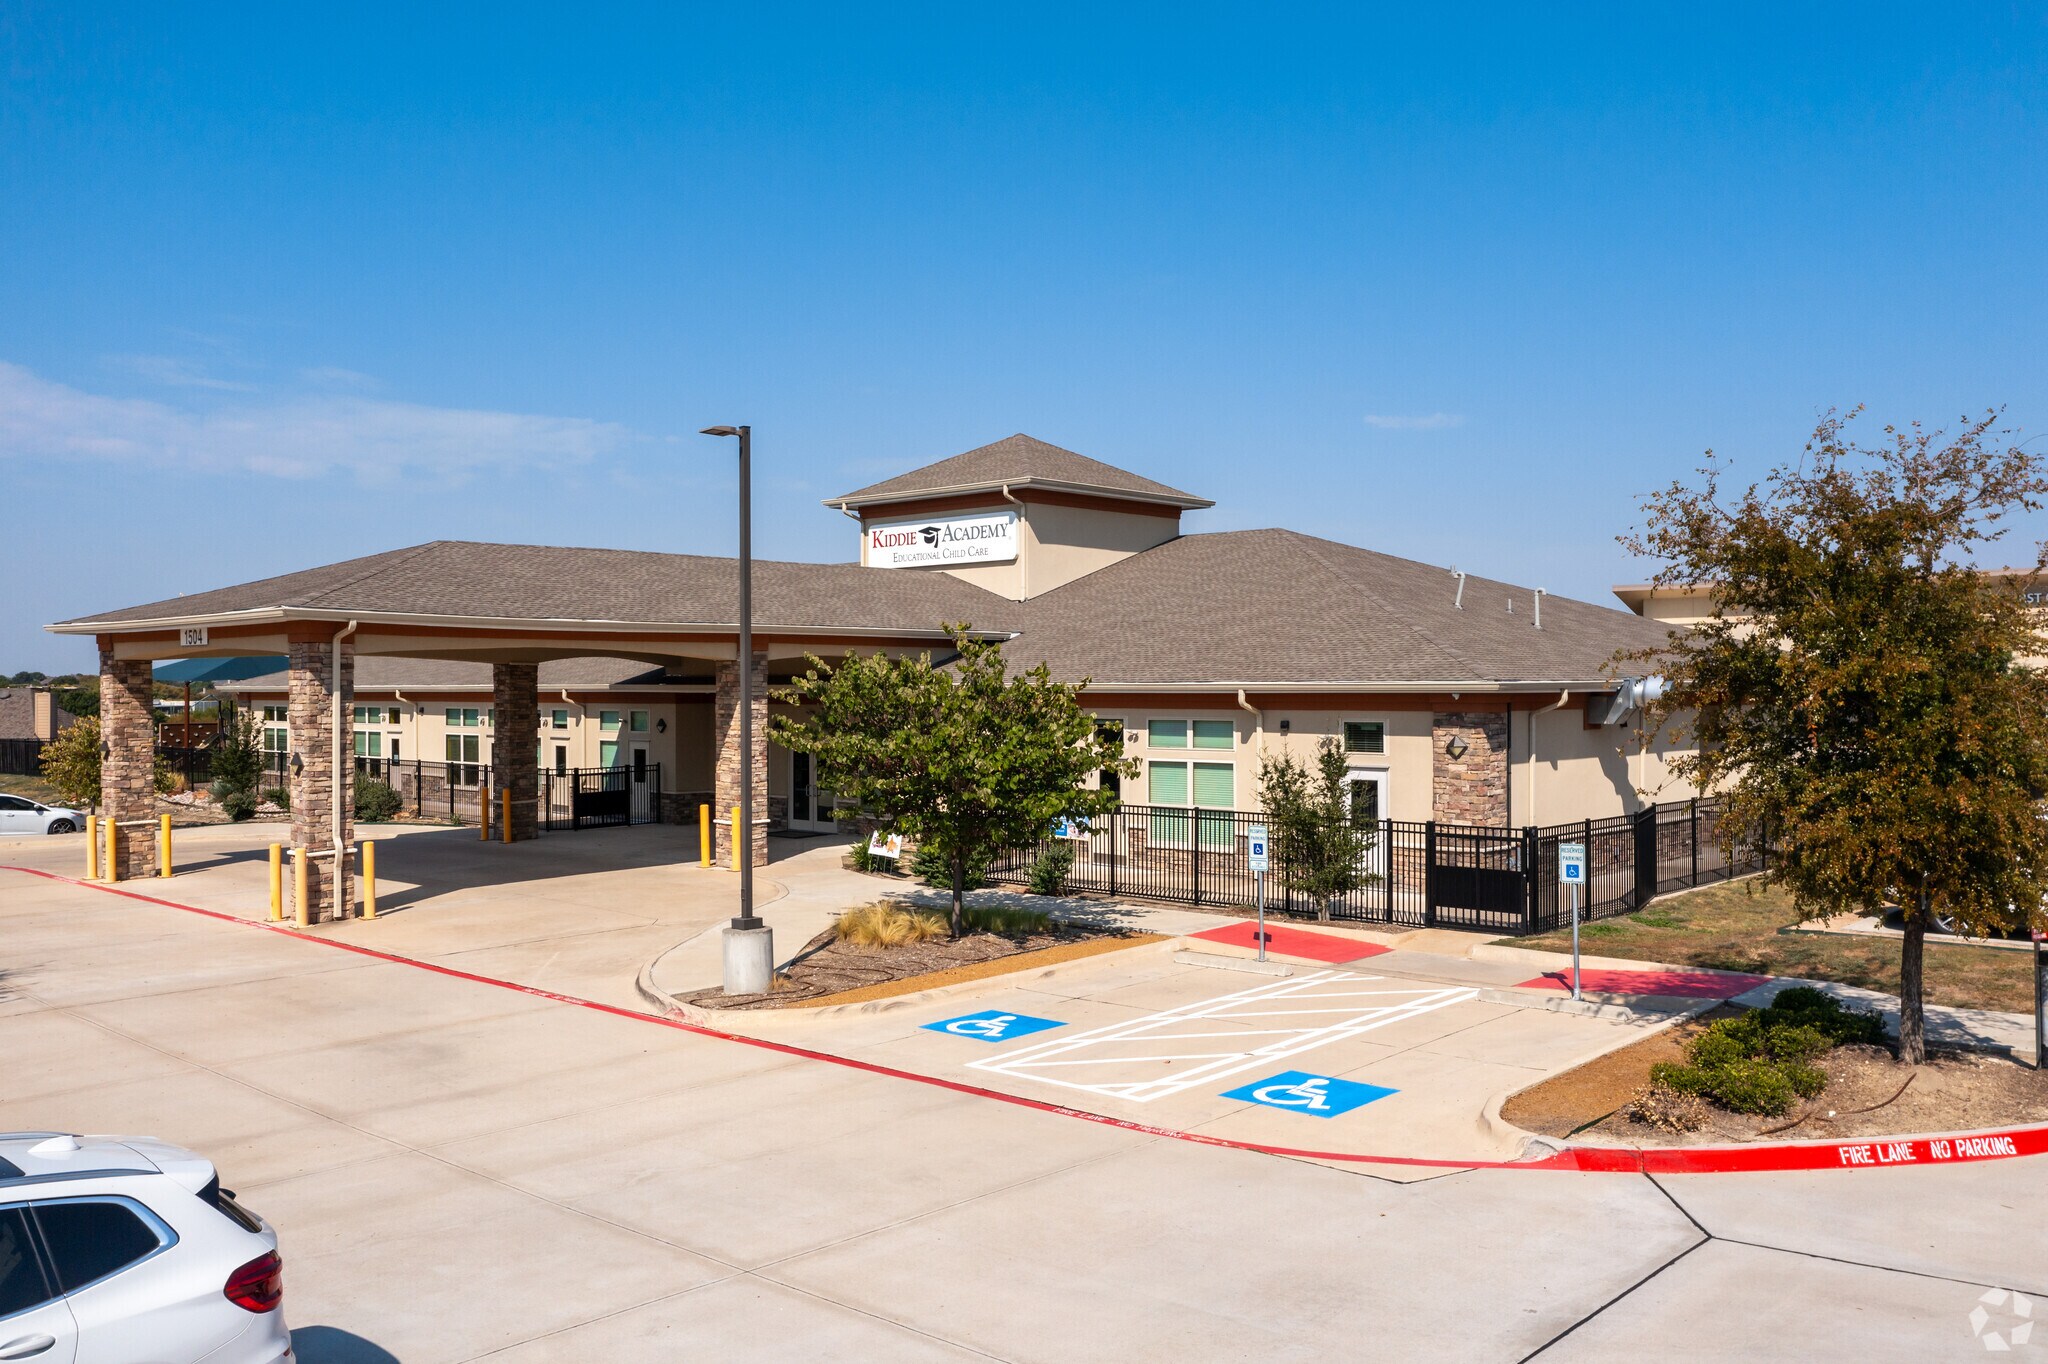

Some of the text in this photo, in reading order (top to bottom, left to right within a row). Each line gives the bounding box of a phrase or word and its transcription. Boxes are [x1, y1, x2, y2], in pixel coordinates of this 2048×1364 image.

[872, 524, 1008, 548] KIDDIE ACADEMY
[184, 629, 203, 645] 1504
[1839, 1136, 2018, 1165] FIRE LANE NO PARKING
